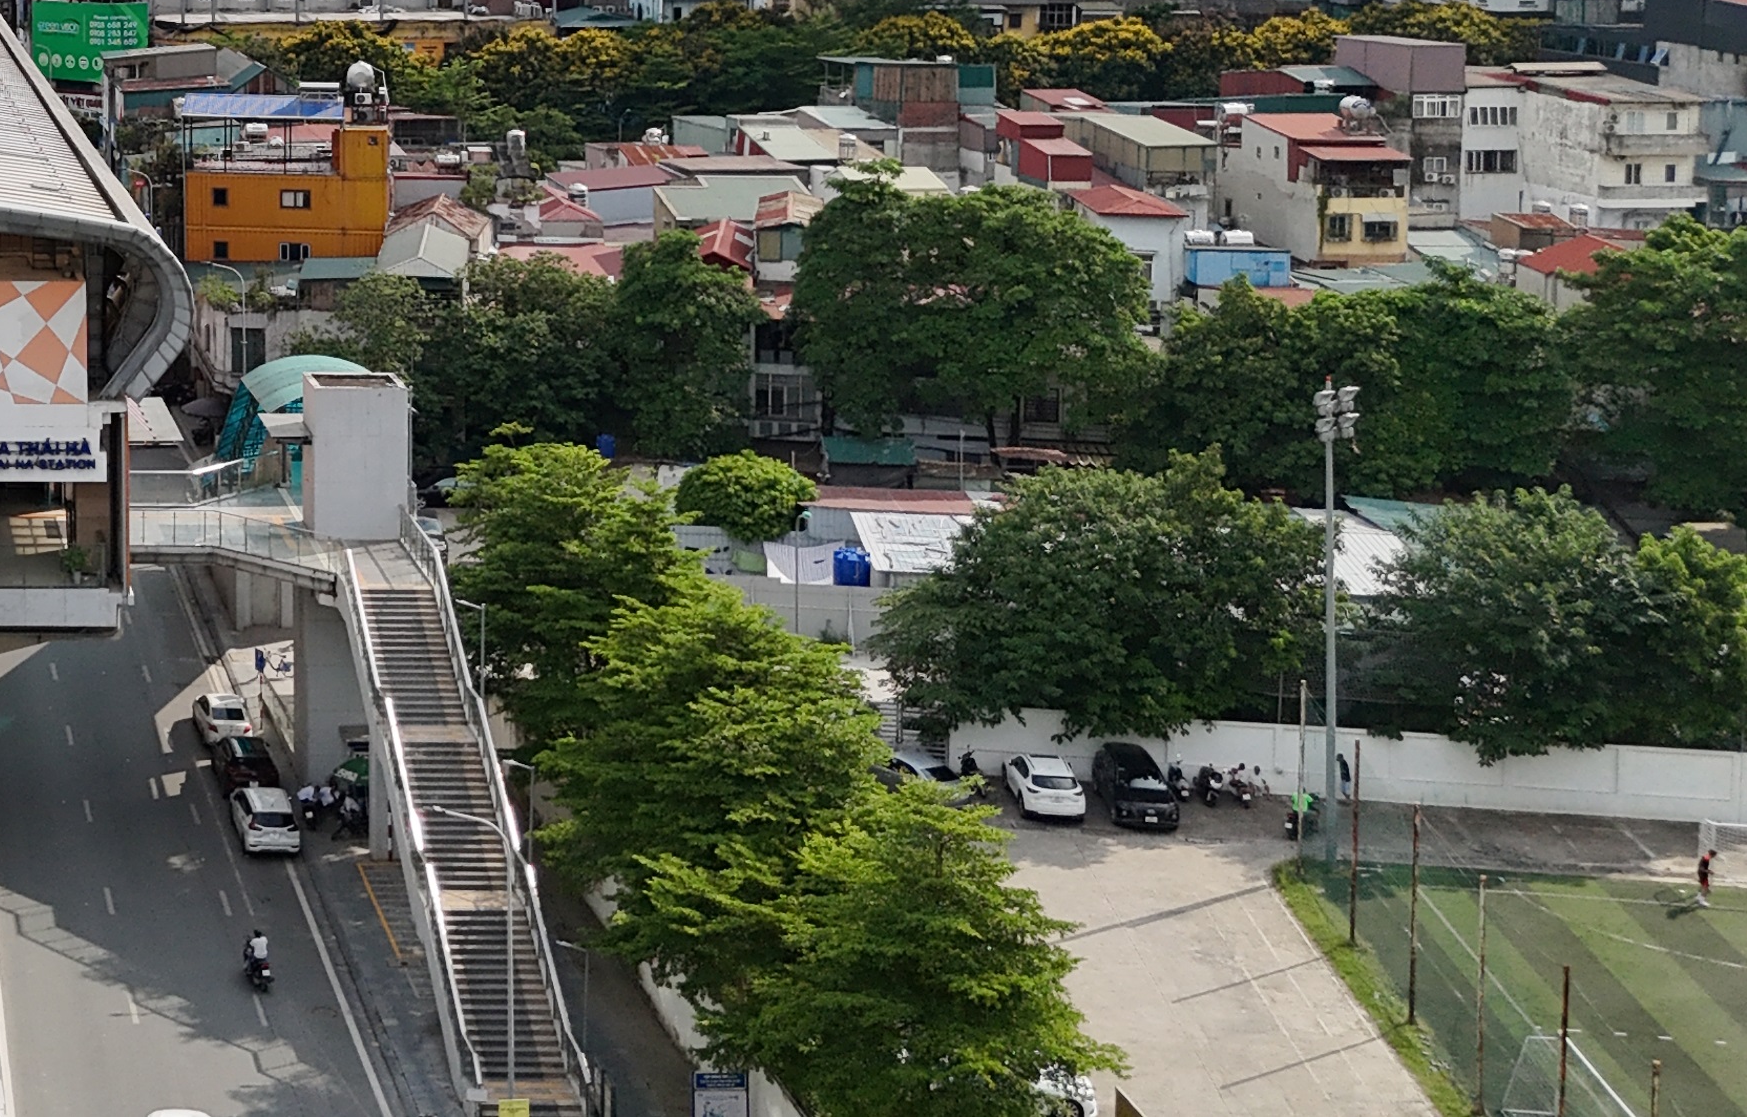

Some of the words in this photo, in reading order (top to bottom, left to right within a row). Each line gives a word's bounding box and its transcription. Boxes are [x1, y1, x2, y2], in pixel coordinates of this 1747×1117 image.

[15, 437, 60, 456] THÁI
[65, 437, 91, 456] HÀ
[37, 459, 96, 471] STATION
